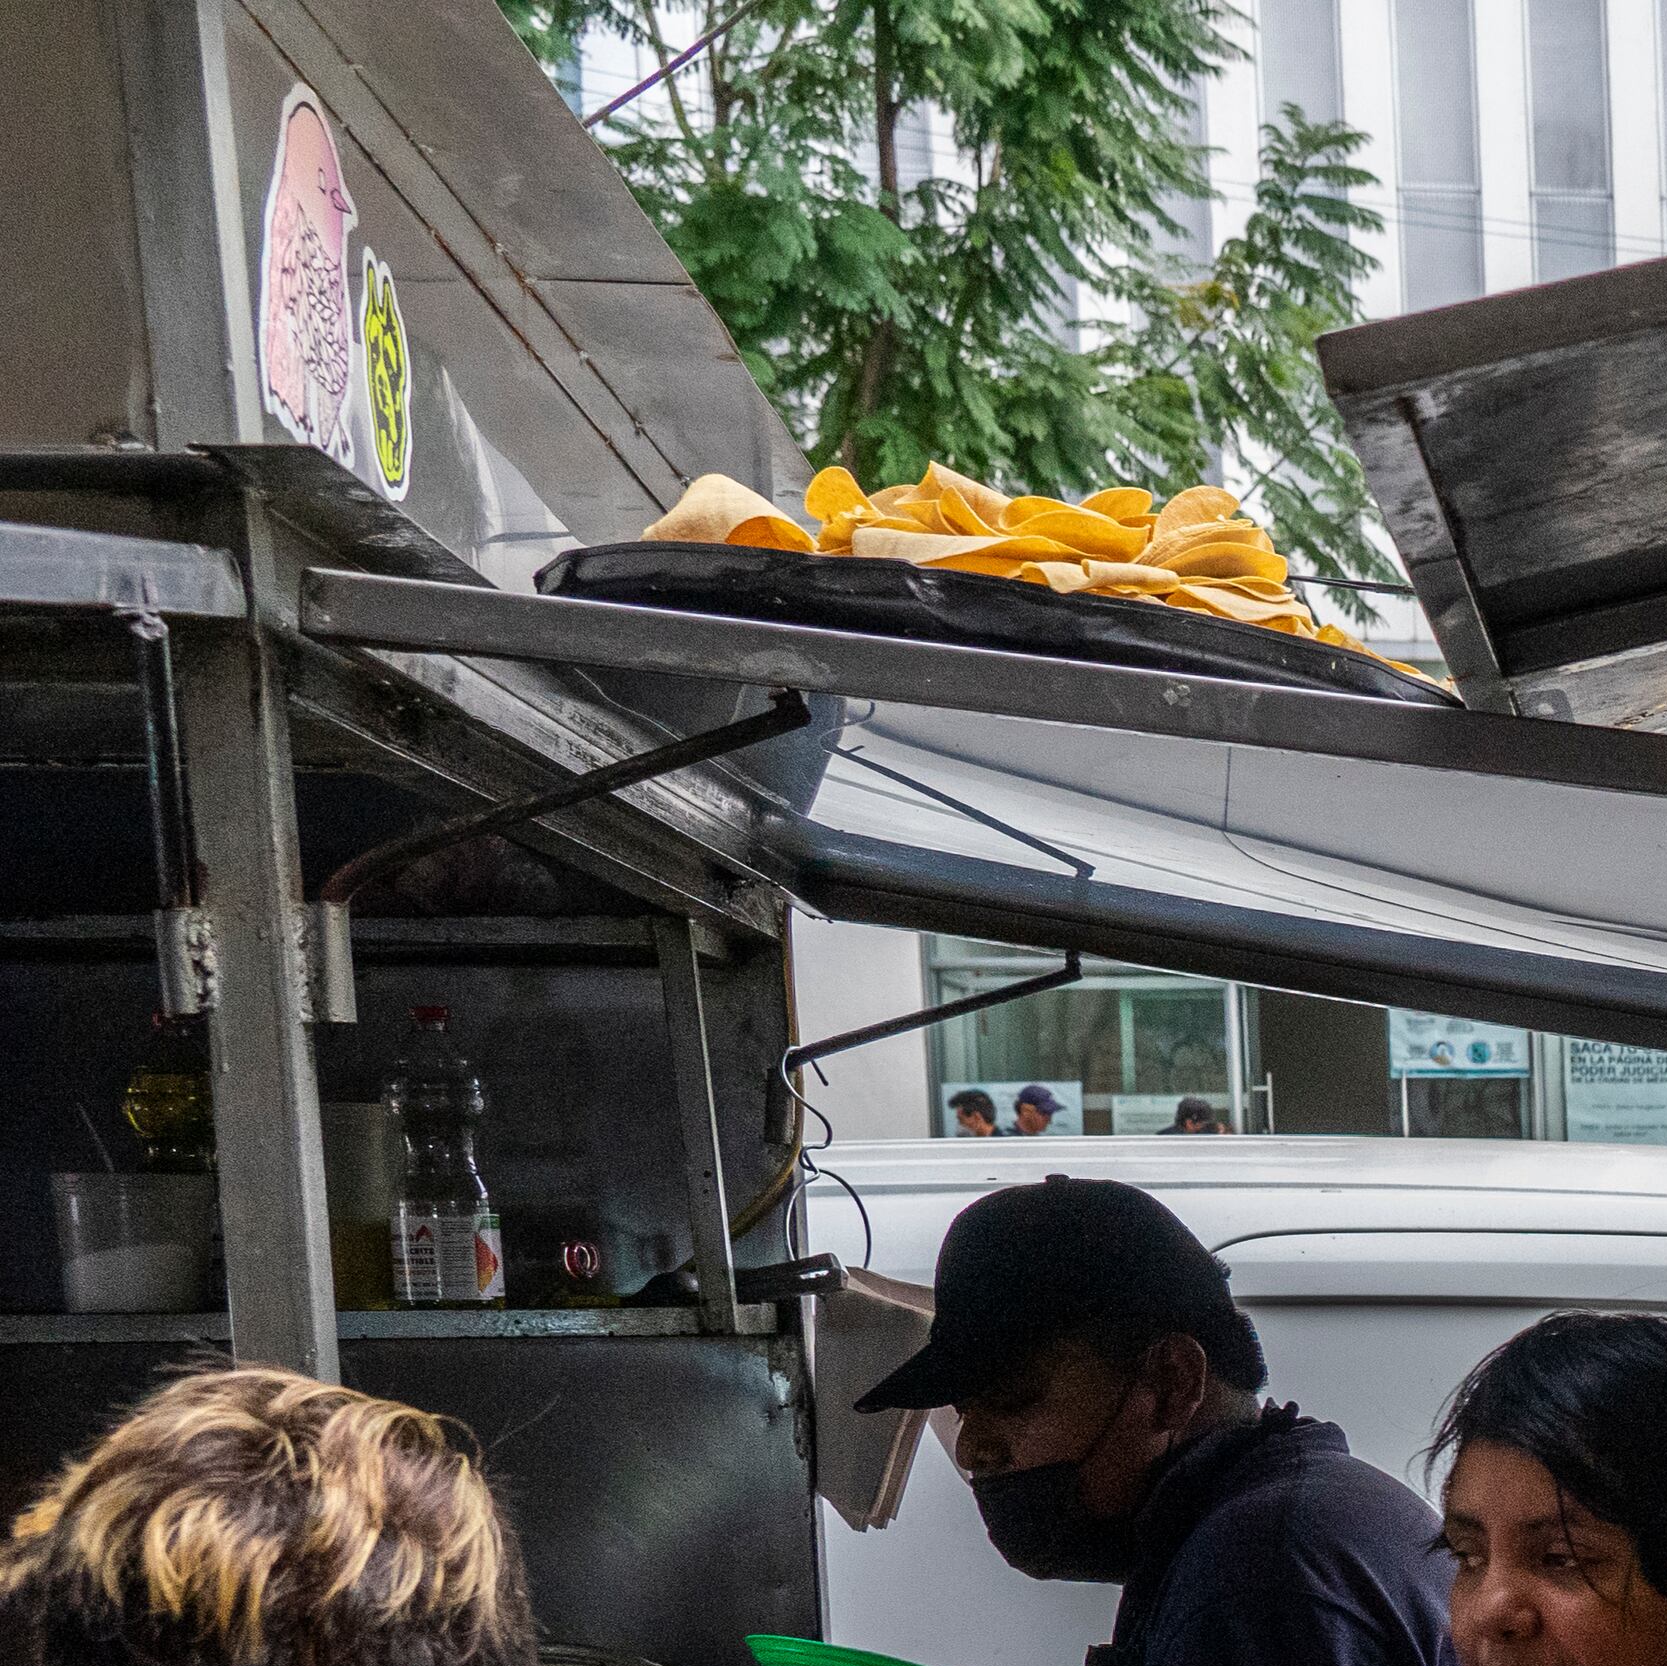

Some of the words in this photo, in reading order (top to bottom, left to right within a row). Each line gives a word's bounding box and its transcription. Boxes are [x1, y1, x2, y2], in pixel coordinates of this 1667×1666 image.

[1570, 1041, 1613, 1054] SACA
[1570, 1056, 1586, 1064] EN
[1590, 1056, 1605, 1064] LA
[1570, 1066, 1616, 1076] PODER
